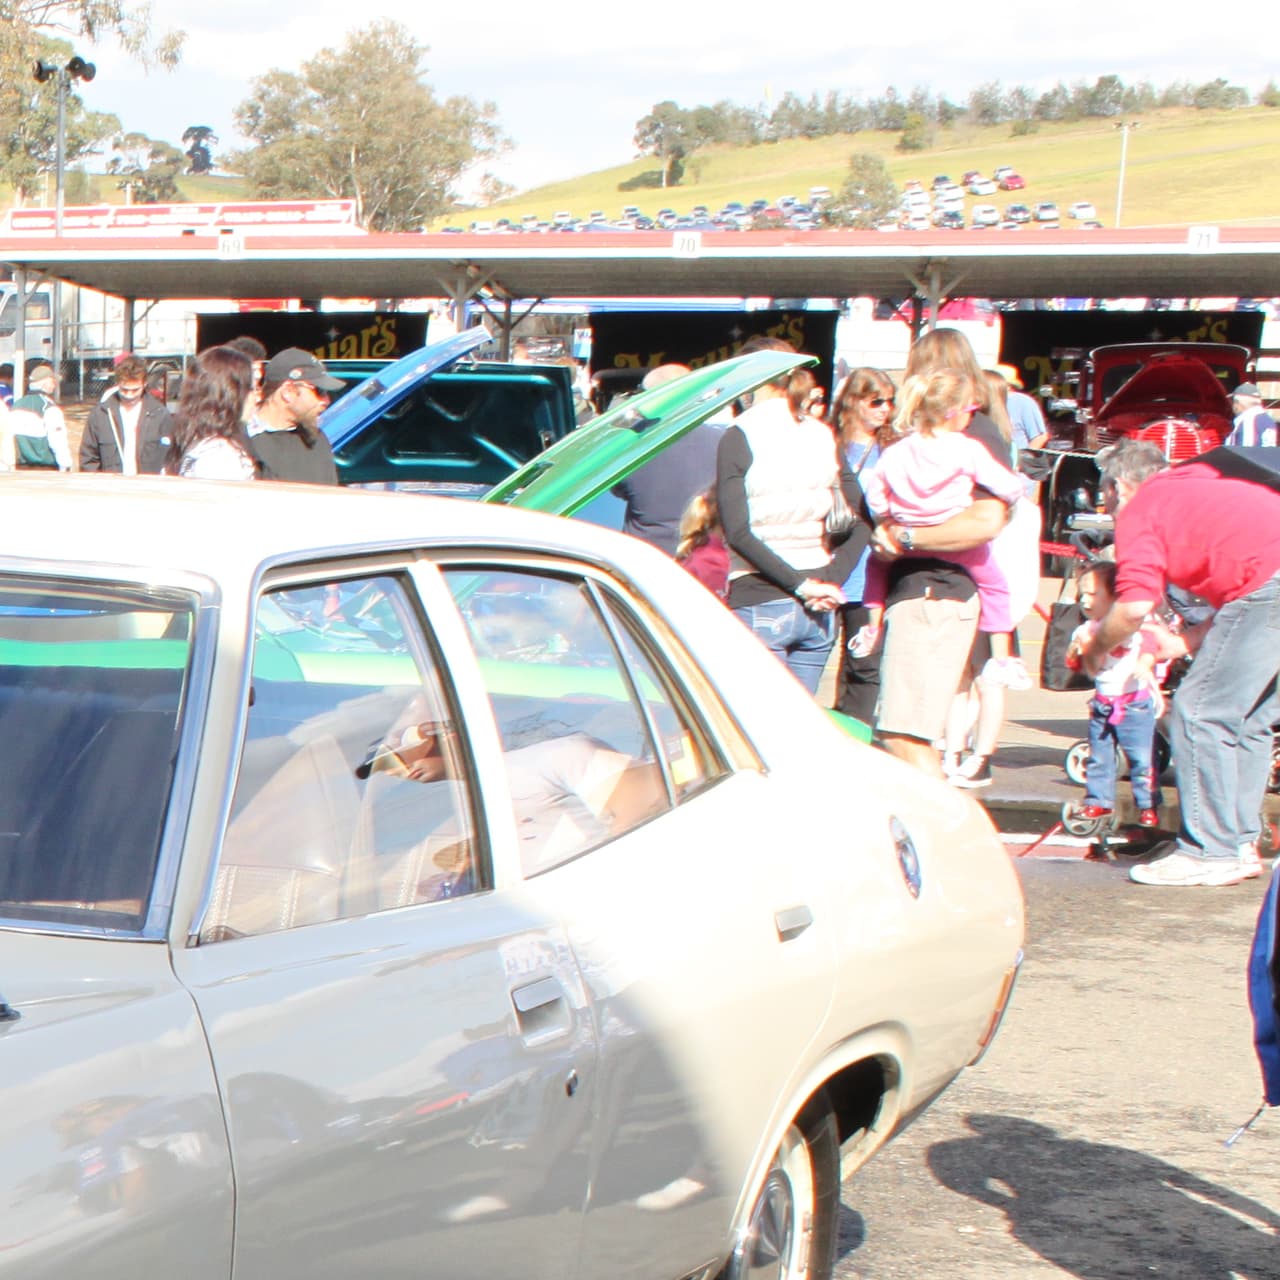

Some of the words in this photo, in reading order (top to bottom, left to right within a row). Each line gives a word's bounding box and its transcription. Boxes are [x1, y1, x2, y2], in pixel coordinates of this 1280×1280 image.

[222, 239, 241, 254] 69
[679, 237, 696, 253] 70
[1195, 232, 1211, 249] 71
